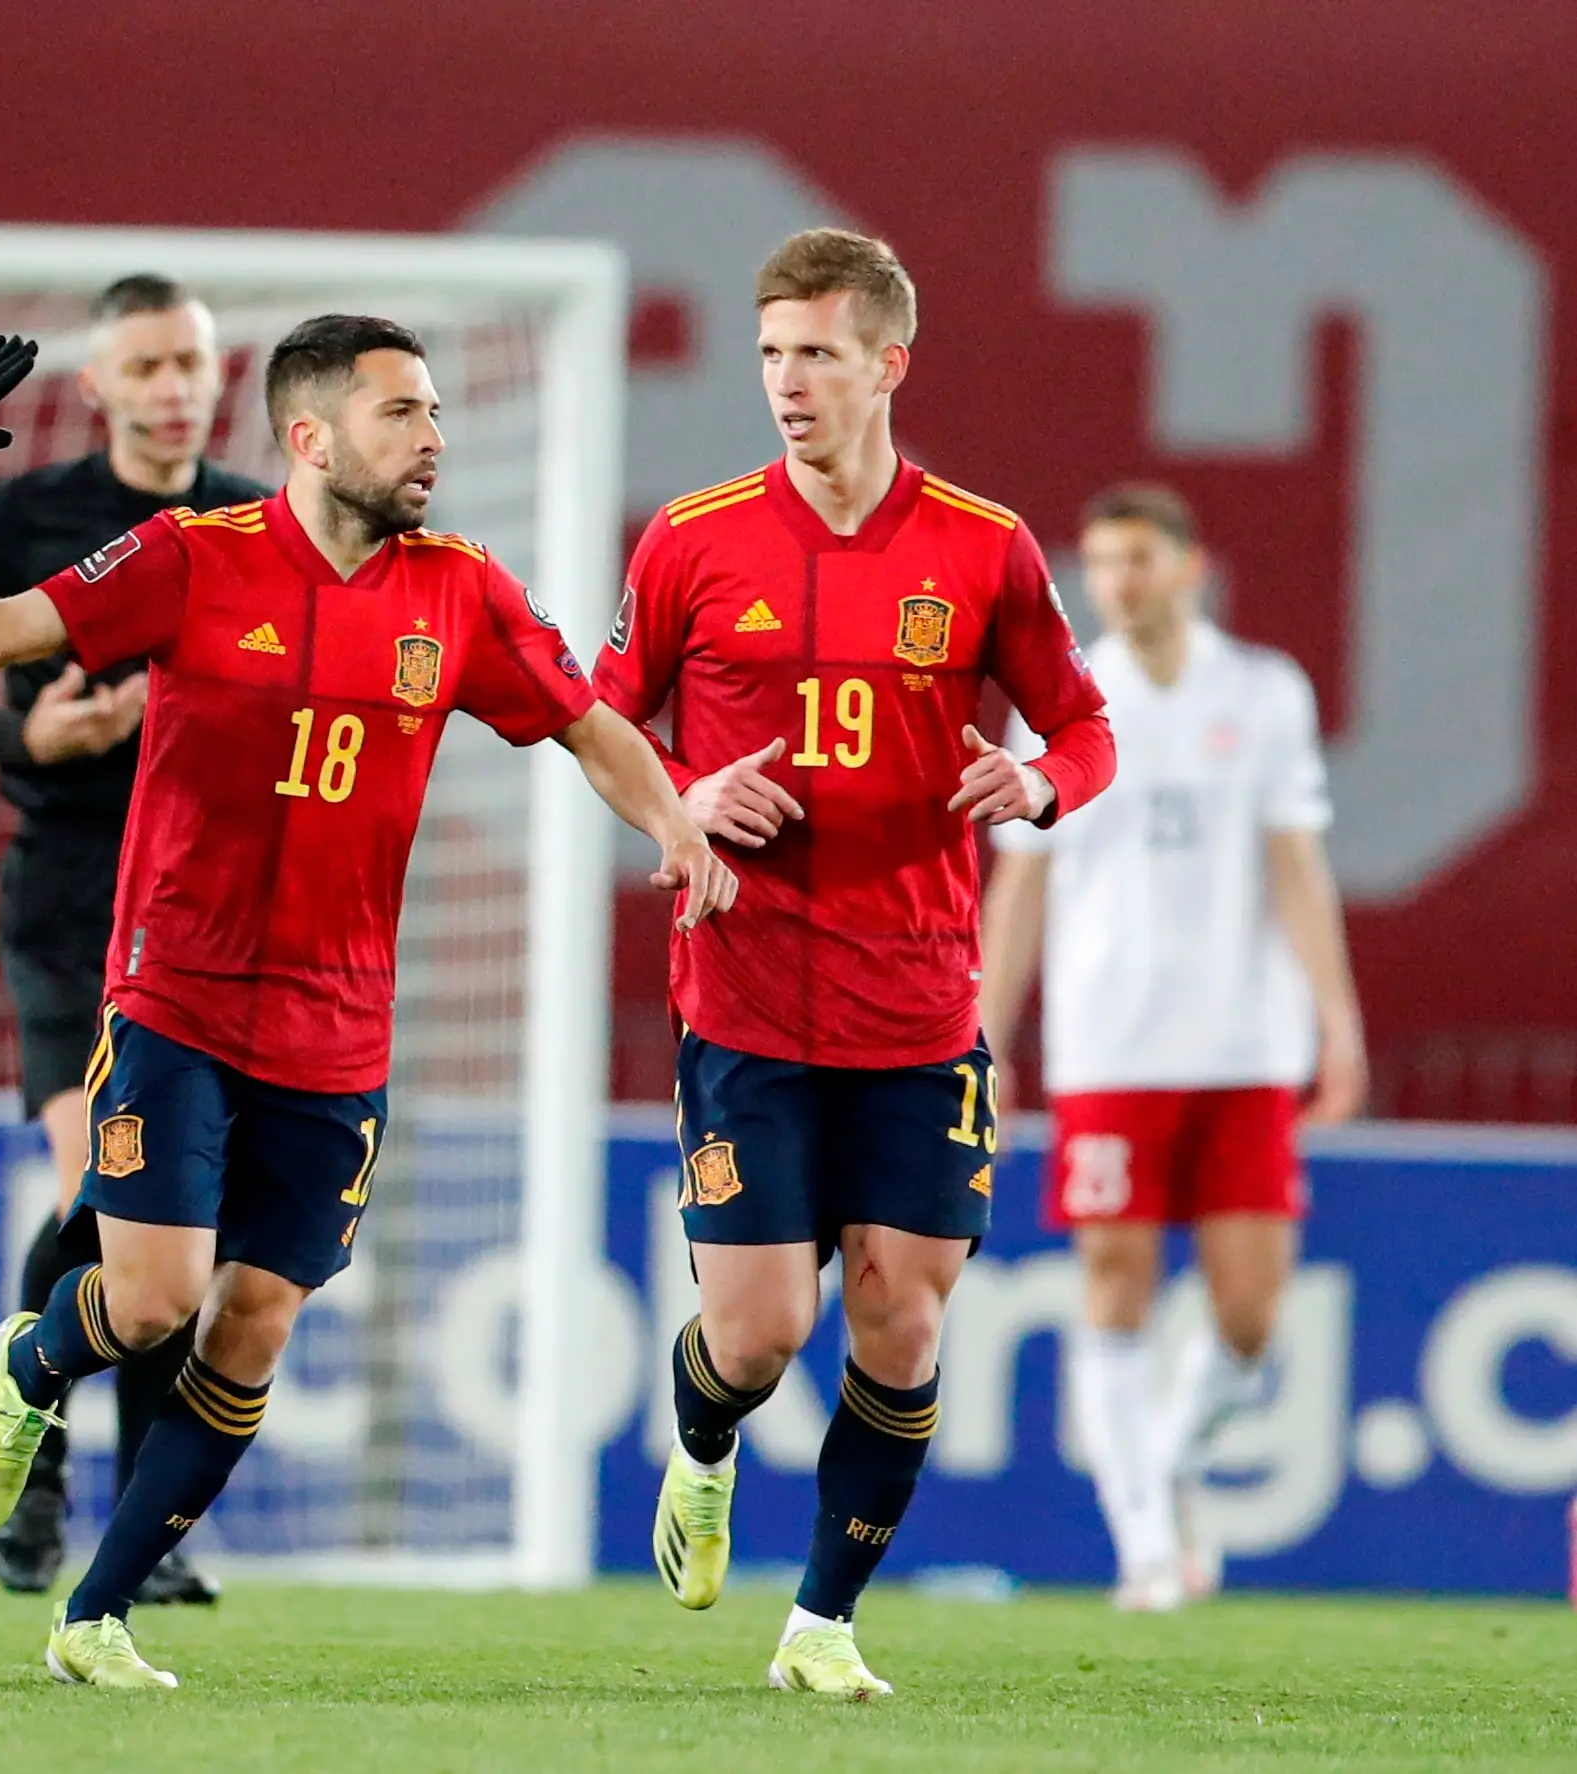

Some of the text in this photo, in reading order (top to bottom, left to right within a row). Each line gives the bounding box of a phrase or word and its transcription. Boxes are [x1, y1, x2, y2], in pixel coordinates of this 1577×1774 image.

[237, 637, 287, 656] adidas
[734, 618, 783, 633] adidas
[274, 707, 366, 803] 18
[791, 677, 874, 769] 19
[340, 1116, 386, 1208] 1
